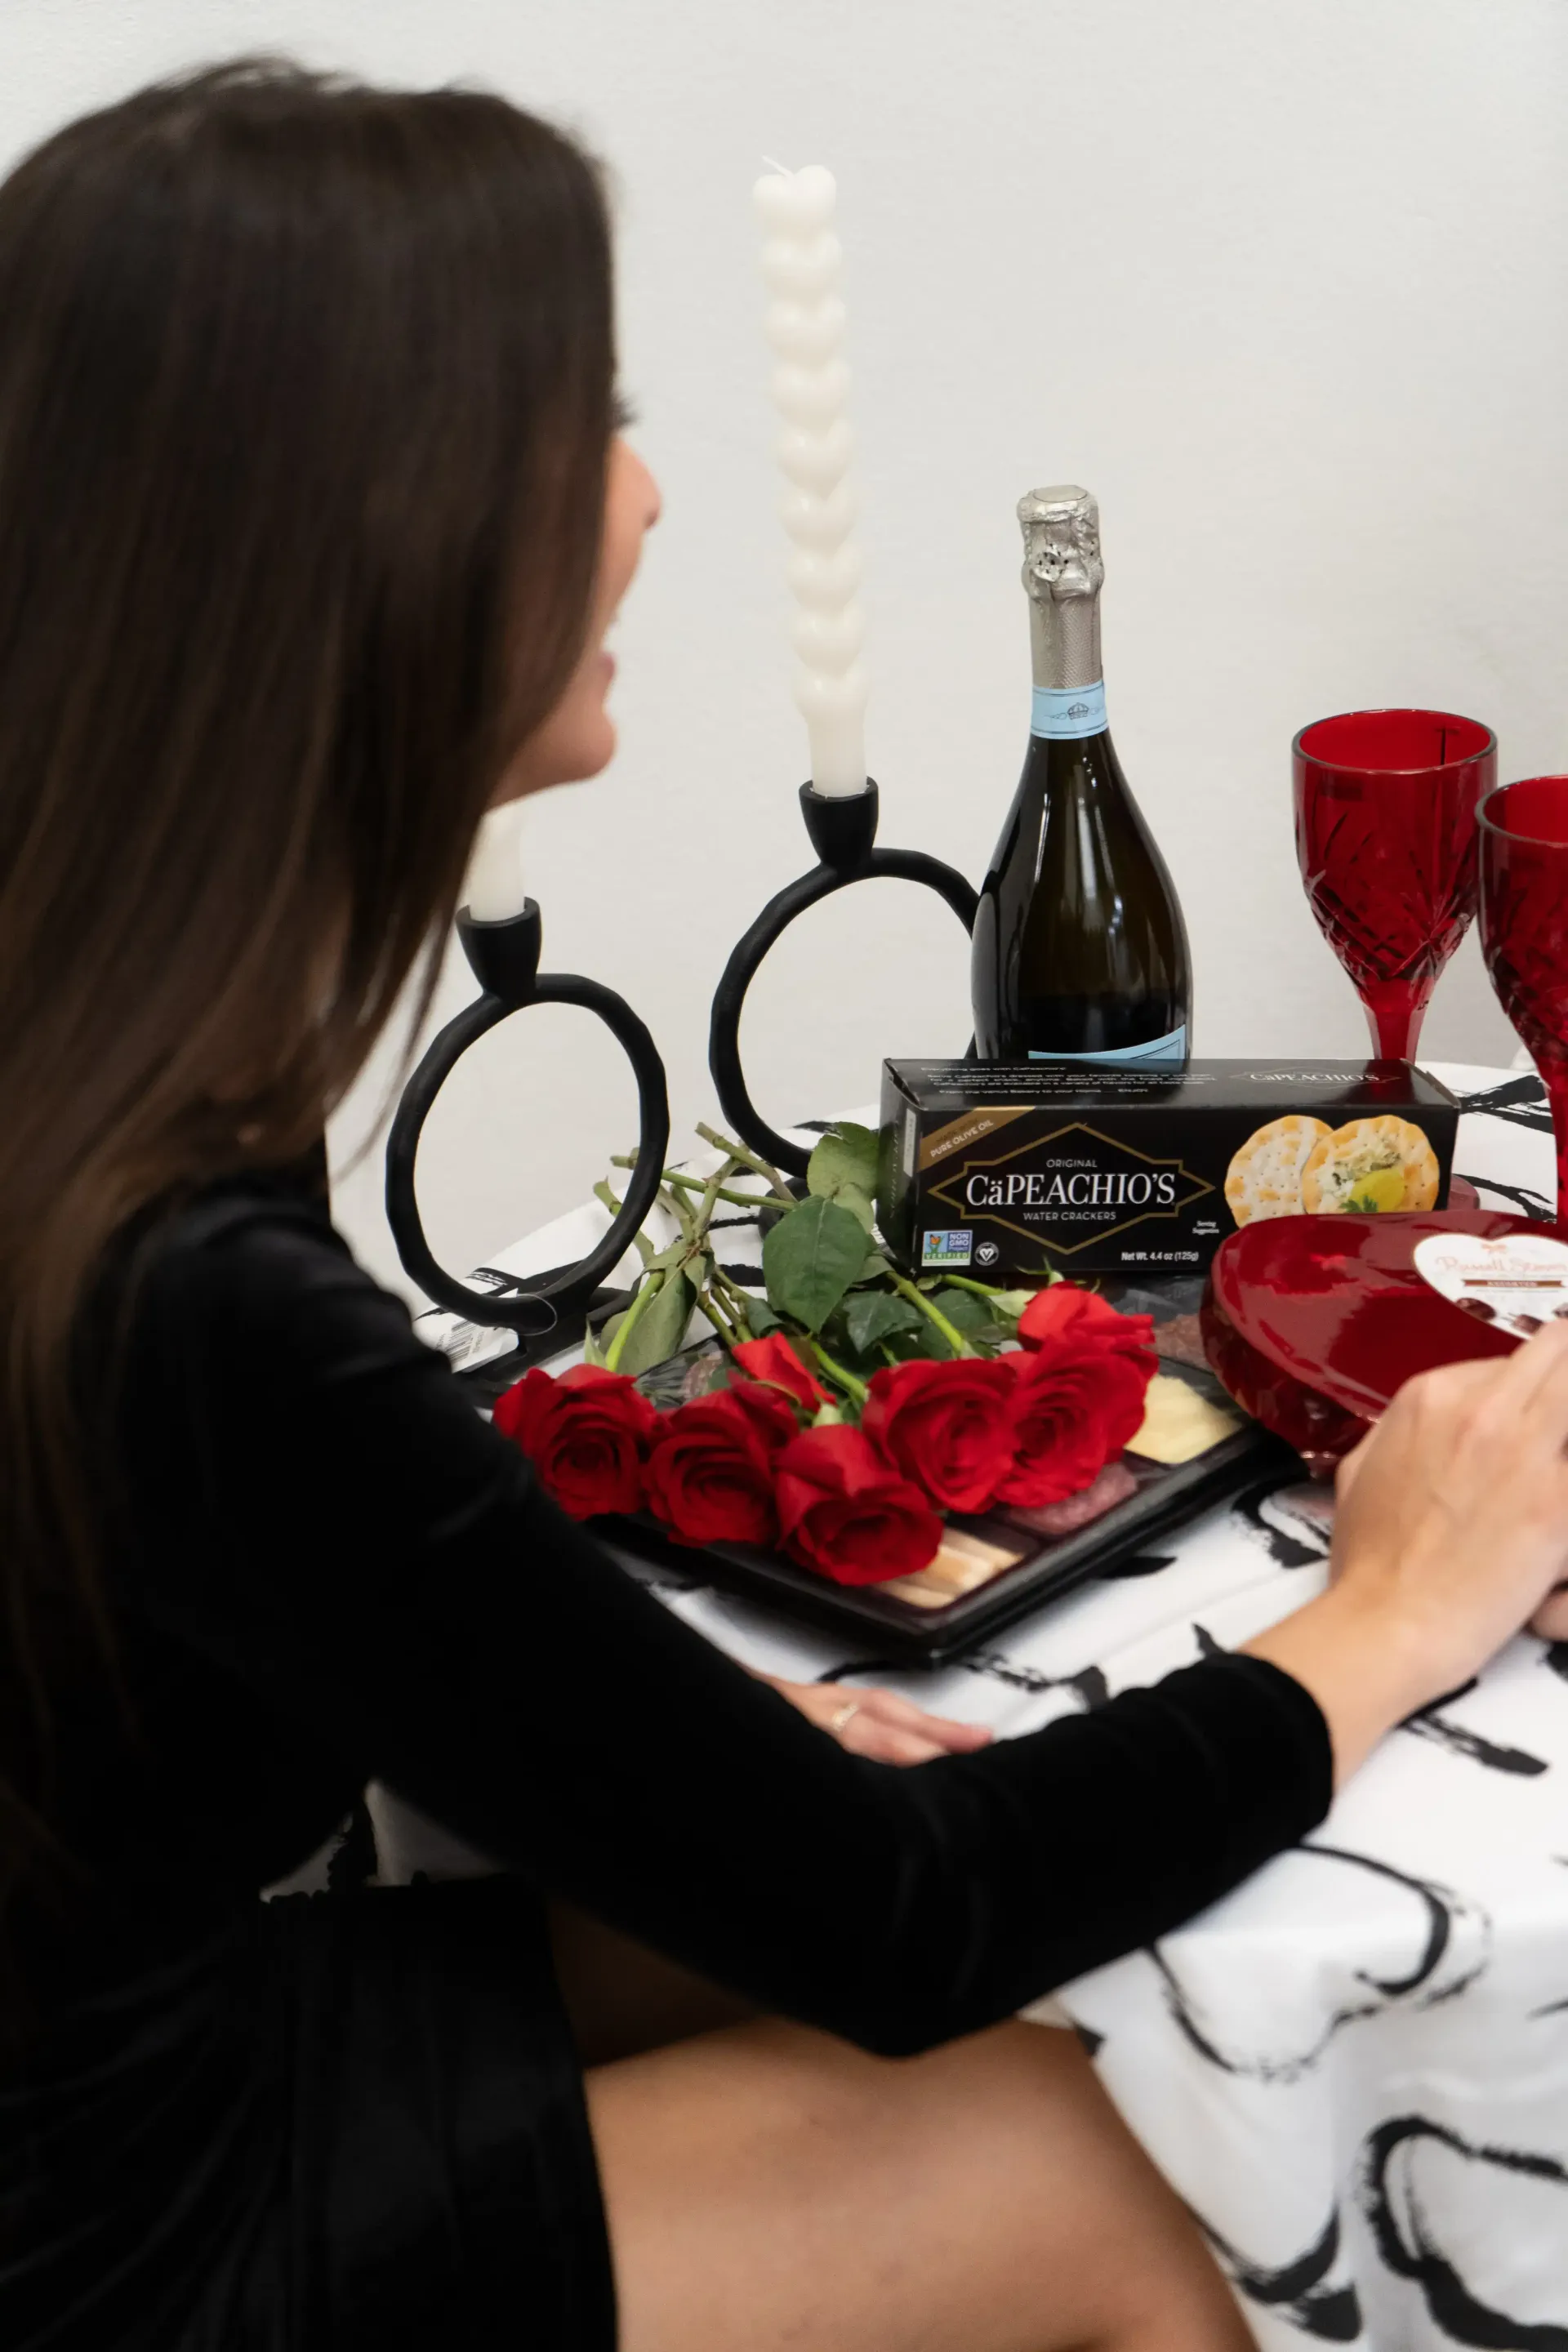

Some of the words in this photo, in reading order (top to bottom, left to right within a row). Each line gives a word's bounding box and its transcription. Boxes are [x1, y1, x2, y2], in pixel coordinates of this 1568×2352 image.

[929, 1142, 953, 1158] PURE
[952, 1127, 978, 1144] OLIVE
[979, 1120, 994, 1131] OIL
[1046, 1159, 1098, 1169] ORIGINAL
[1023, 1212, 1058, 1221] WATER
[1061, 1211, 1116, 1221] CRACKERS
[1121, 1252, 1135, 1260] Net
[1136, 1252, 1148, 1260] Wt.
[1150, 1252, 1163, 1260] 4.4
[1174, 1252, 1199, 1262] (125g)
